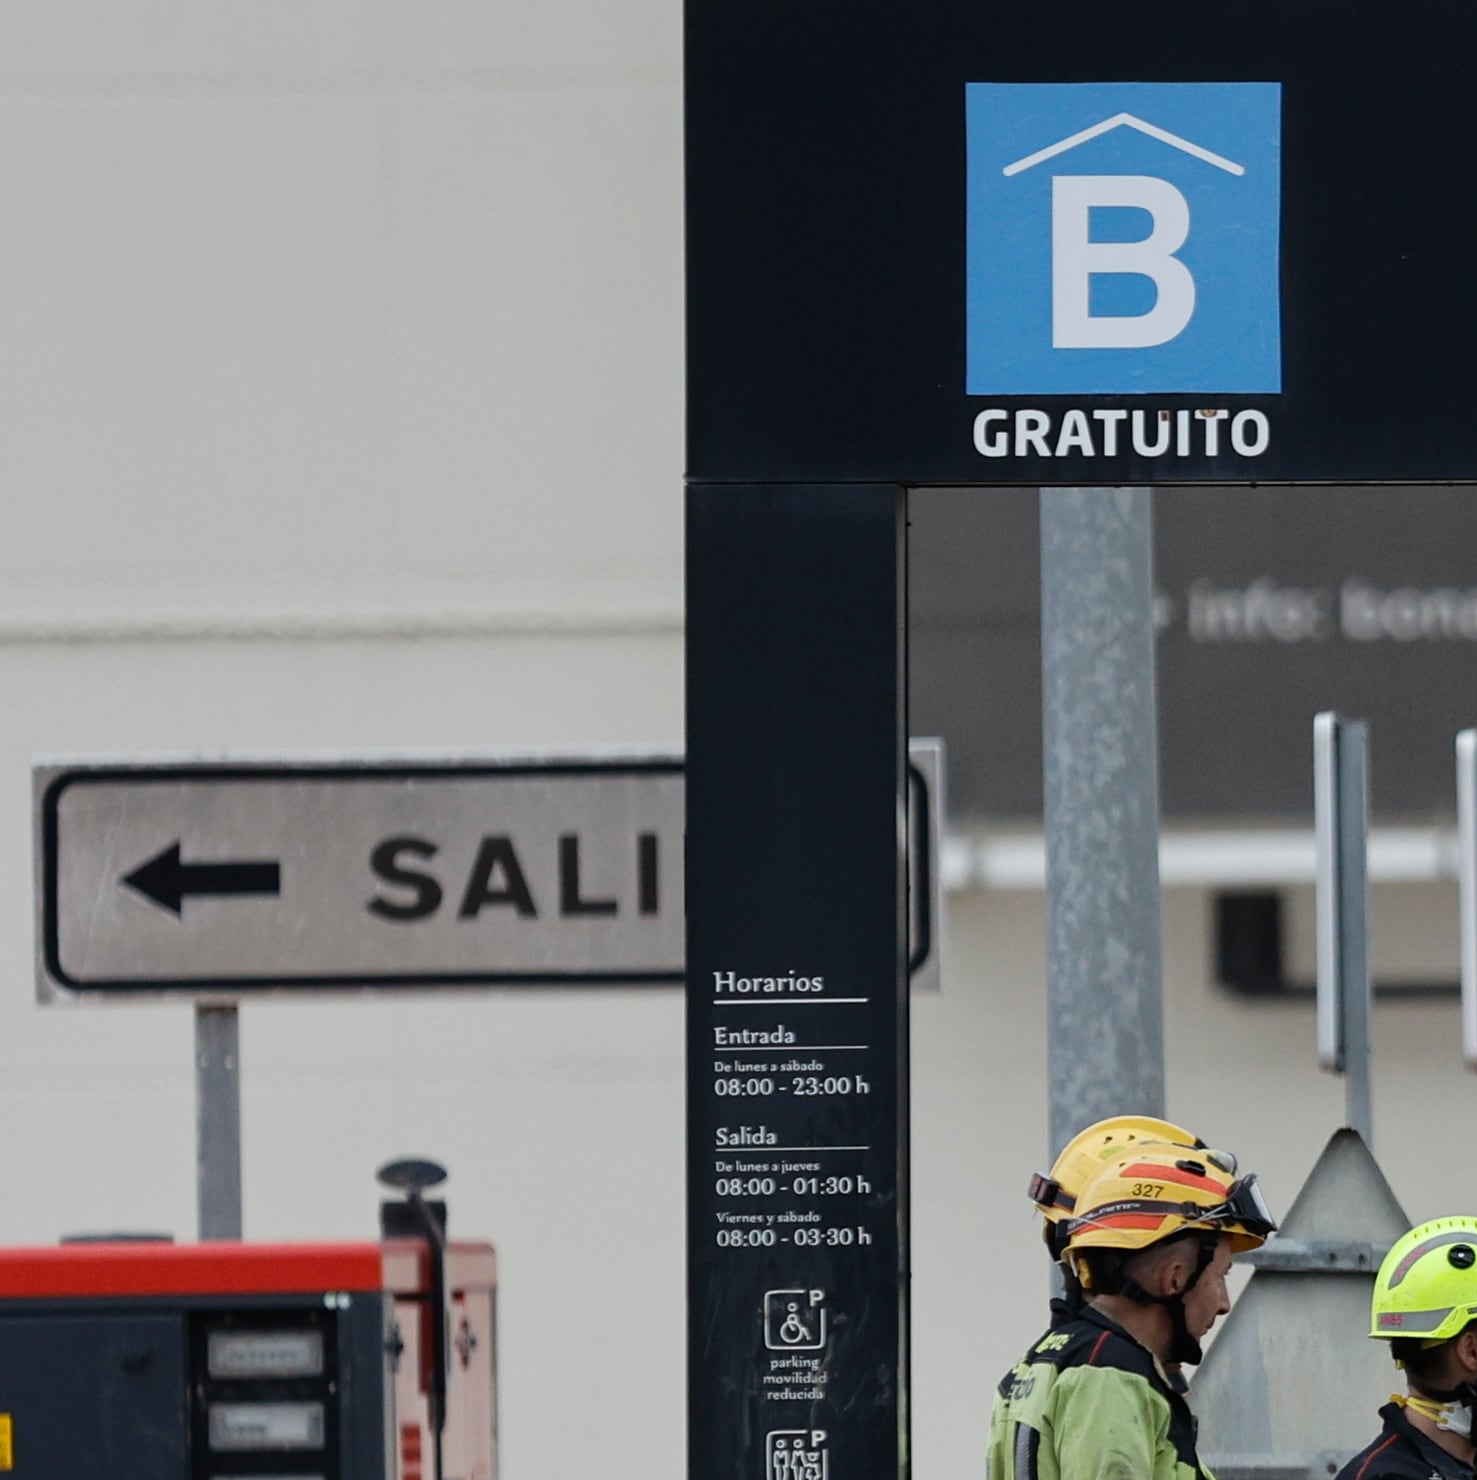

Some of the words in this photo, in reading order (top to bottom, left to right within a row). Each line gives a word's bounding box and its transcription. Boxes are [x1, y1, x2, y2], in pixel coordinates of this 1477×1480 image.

[1052, 175, 1196, 349] B
[973, 408, 1270, 457] GRATUITO
[367, 832, 661, 923] SALI
[712, 969, 823, 993] Horarios
[714, 1024, 795, 1045] Entrada
[714, 1061, 732, 1072] De
[734, 1060, 767, 1072] lunes
[770, 1063, 777, 1072] a
[780, 1059, 823, 1072] sábado
[714, 1078, 773, 1096] 08:00
[792, 1077, 851, 1096] 23:00
[855, 1075, 869, 1094] h
[716, 1126, 776, 1146] Salida
[715, 1161, 733, 1172] De
[735, 1160, 768, 1172] lunes
[771, 1163, 779, 1172] a
[781, 1160, 820, 1174] jueves
[716, 1178, 774, 1196] 08:00
[793, 1176, 852, 1195] 01:30
[857, 1175, 870, 1194] h
[1131, 1182, 1165, 1200] 327
[716, 1212, 763, 1223] Viernes
[766, 1215, 774, 1226] y
[777, 1211, 820, 1223] sábado
[716, 1229, 775, 1247] 08:00
[857, 1226, 871, 1245] h
[770, 1355, 820, 1371] parking
[763, 1371, 827, 1384] movilidad
[767, 1387, 824, 1400] reducida
